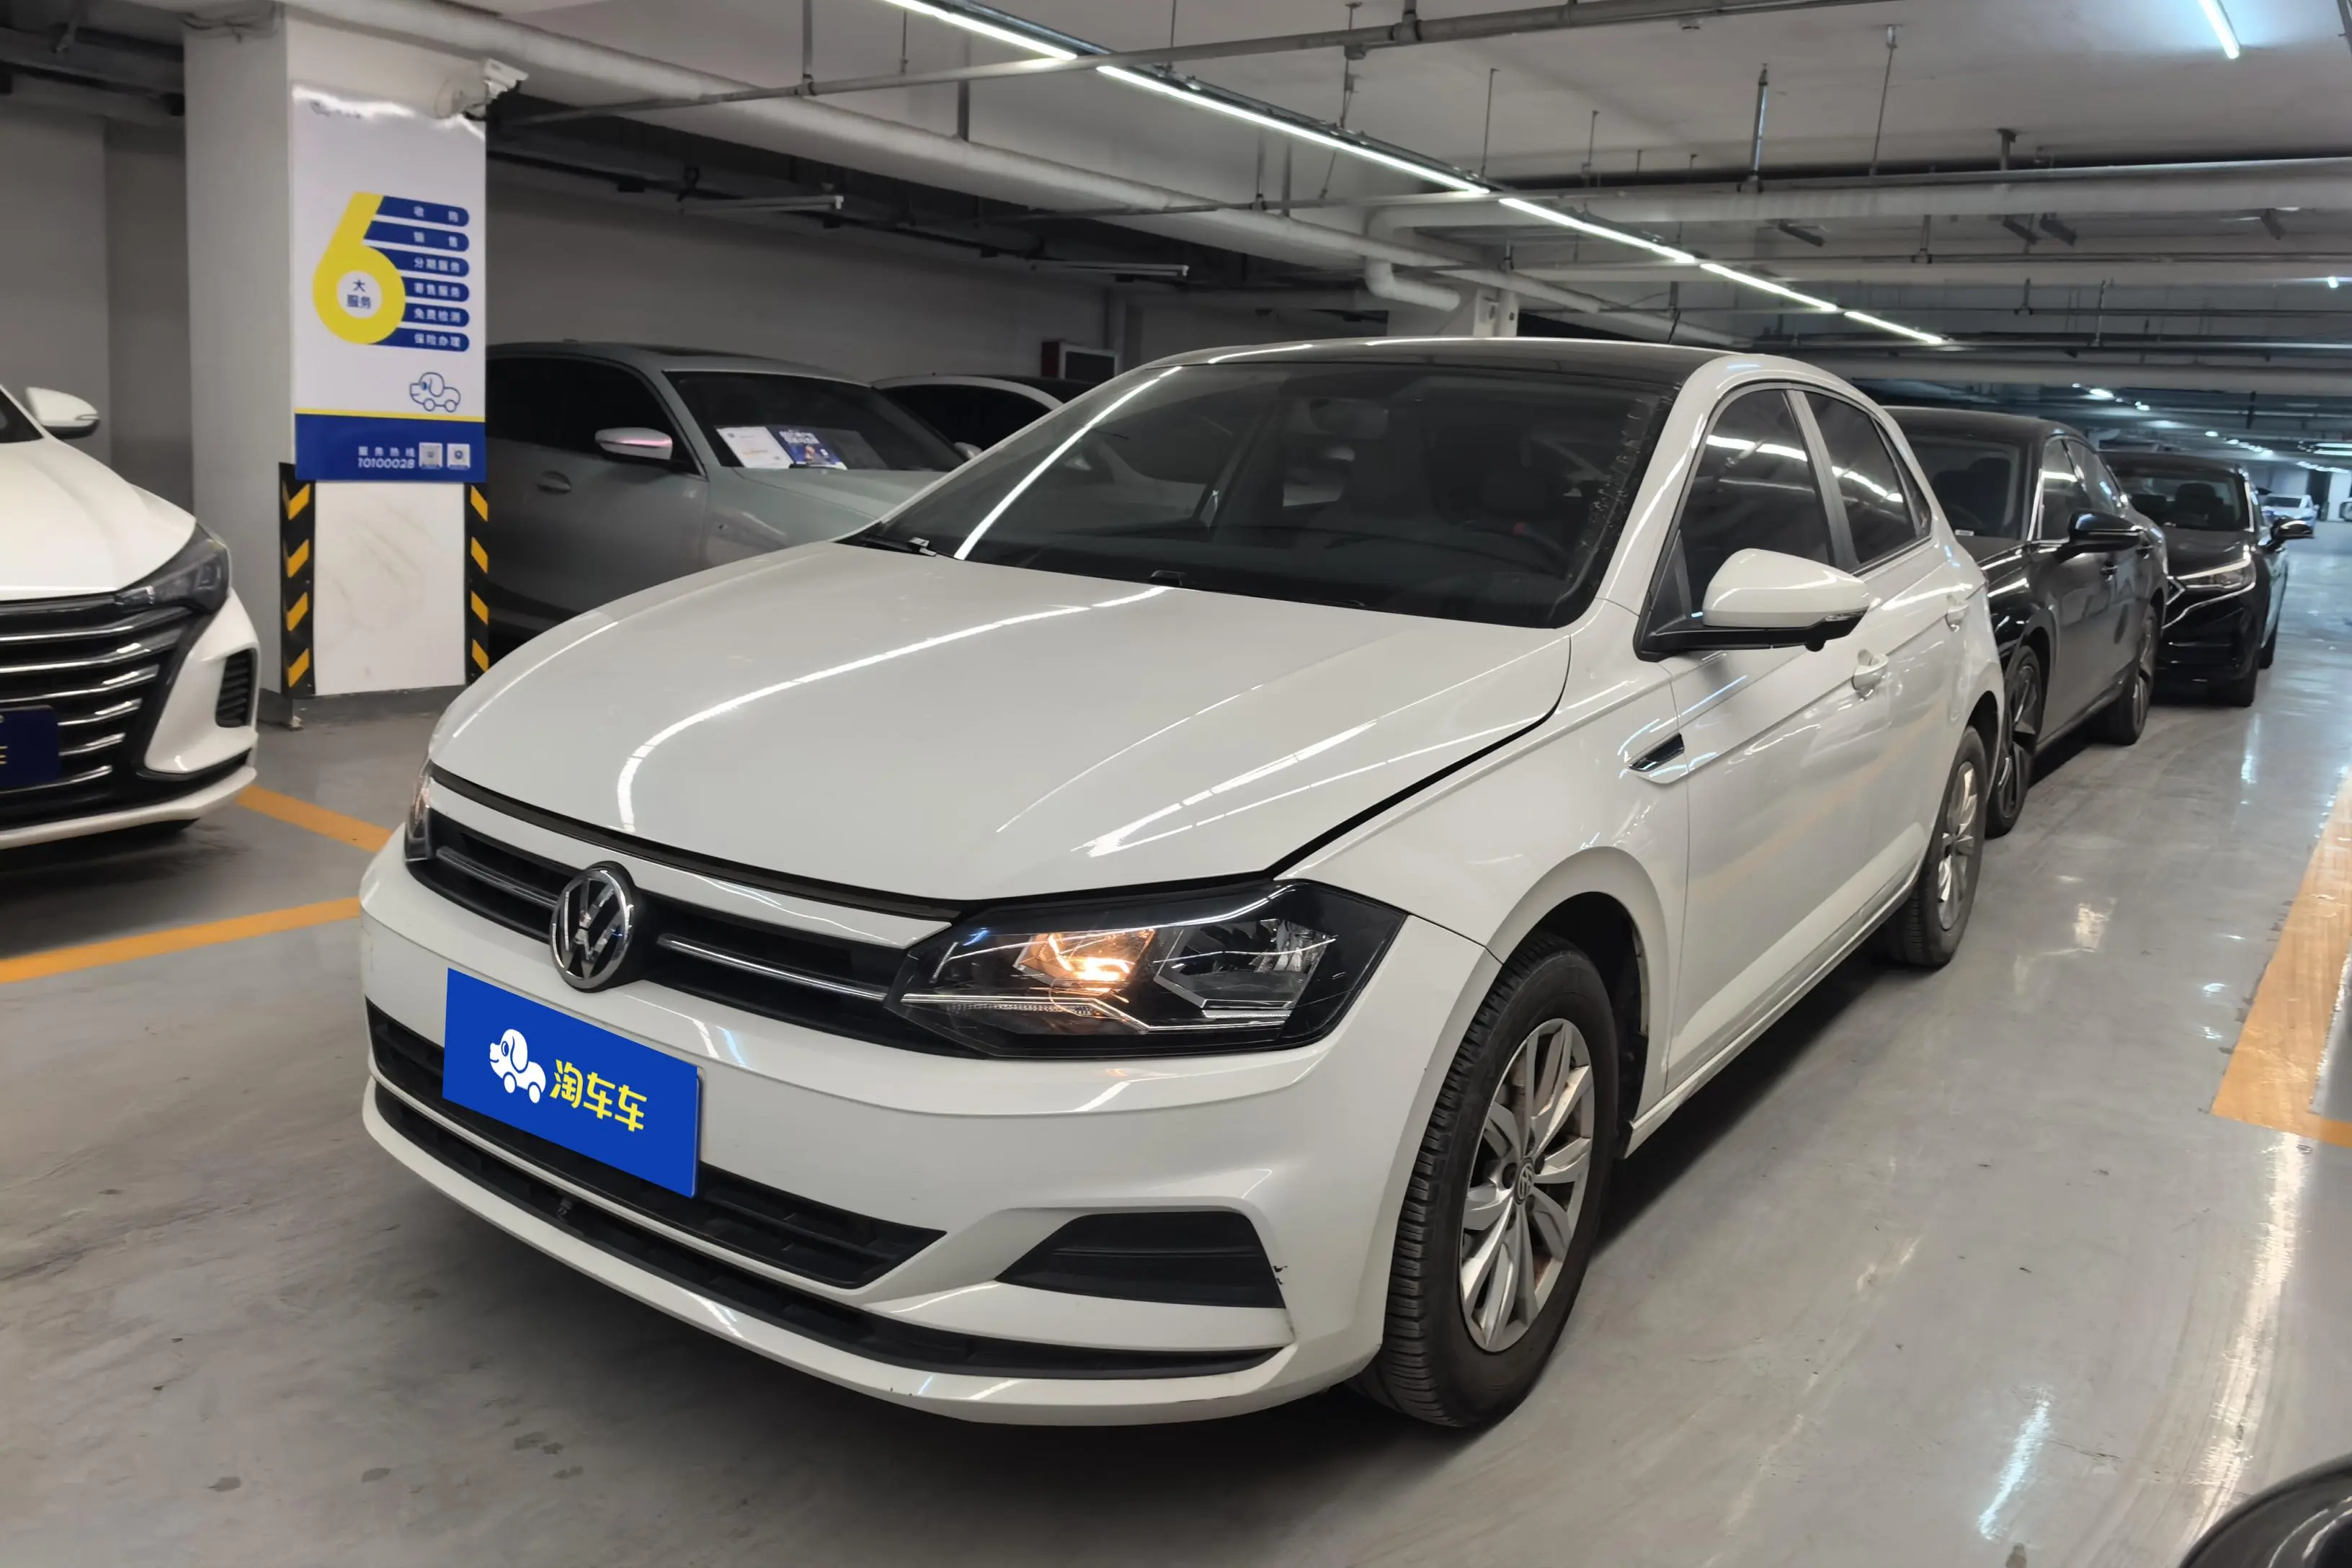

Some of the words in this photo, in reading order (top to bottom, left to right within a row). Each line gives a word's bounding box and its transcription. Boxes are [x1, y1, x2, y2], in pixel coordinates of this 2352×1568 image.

[353, 280, 366, 292] 大
[347, 294, 372, 310] 服务
[358, 458, 416, 469] 10100028
